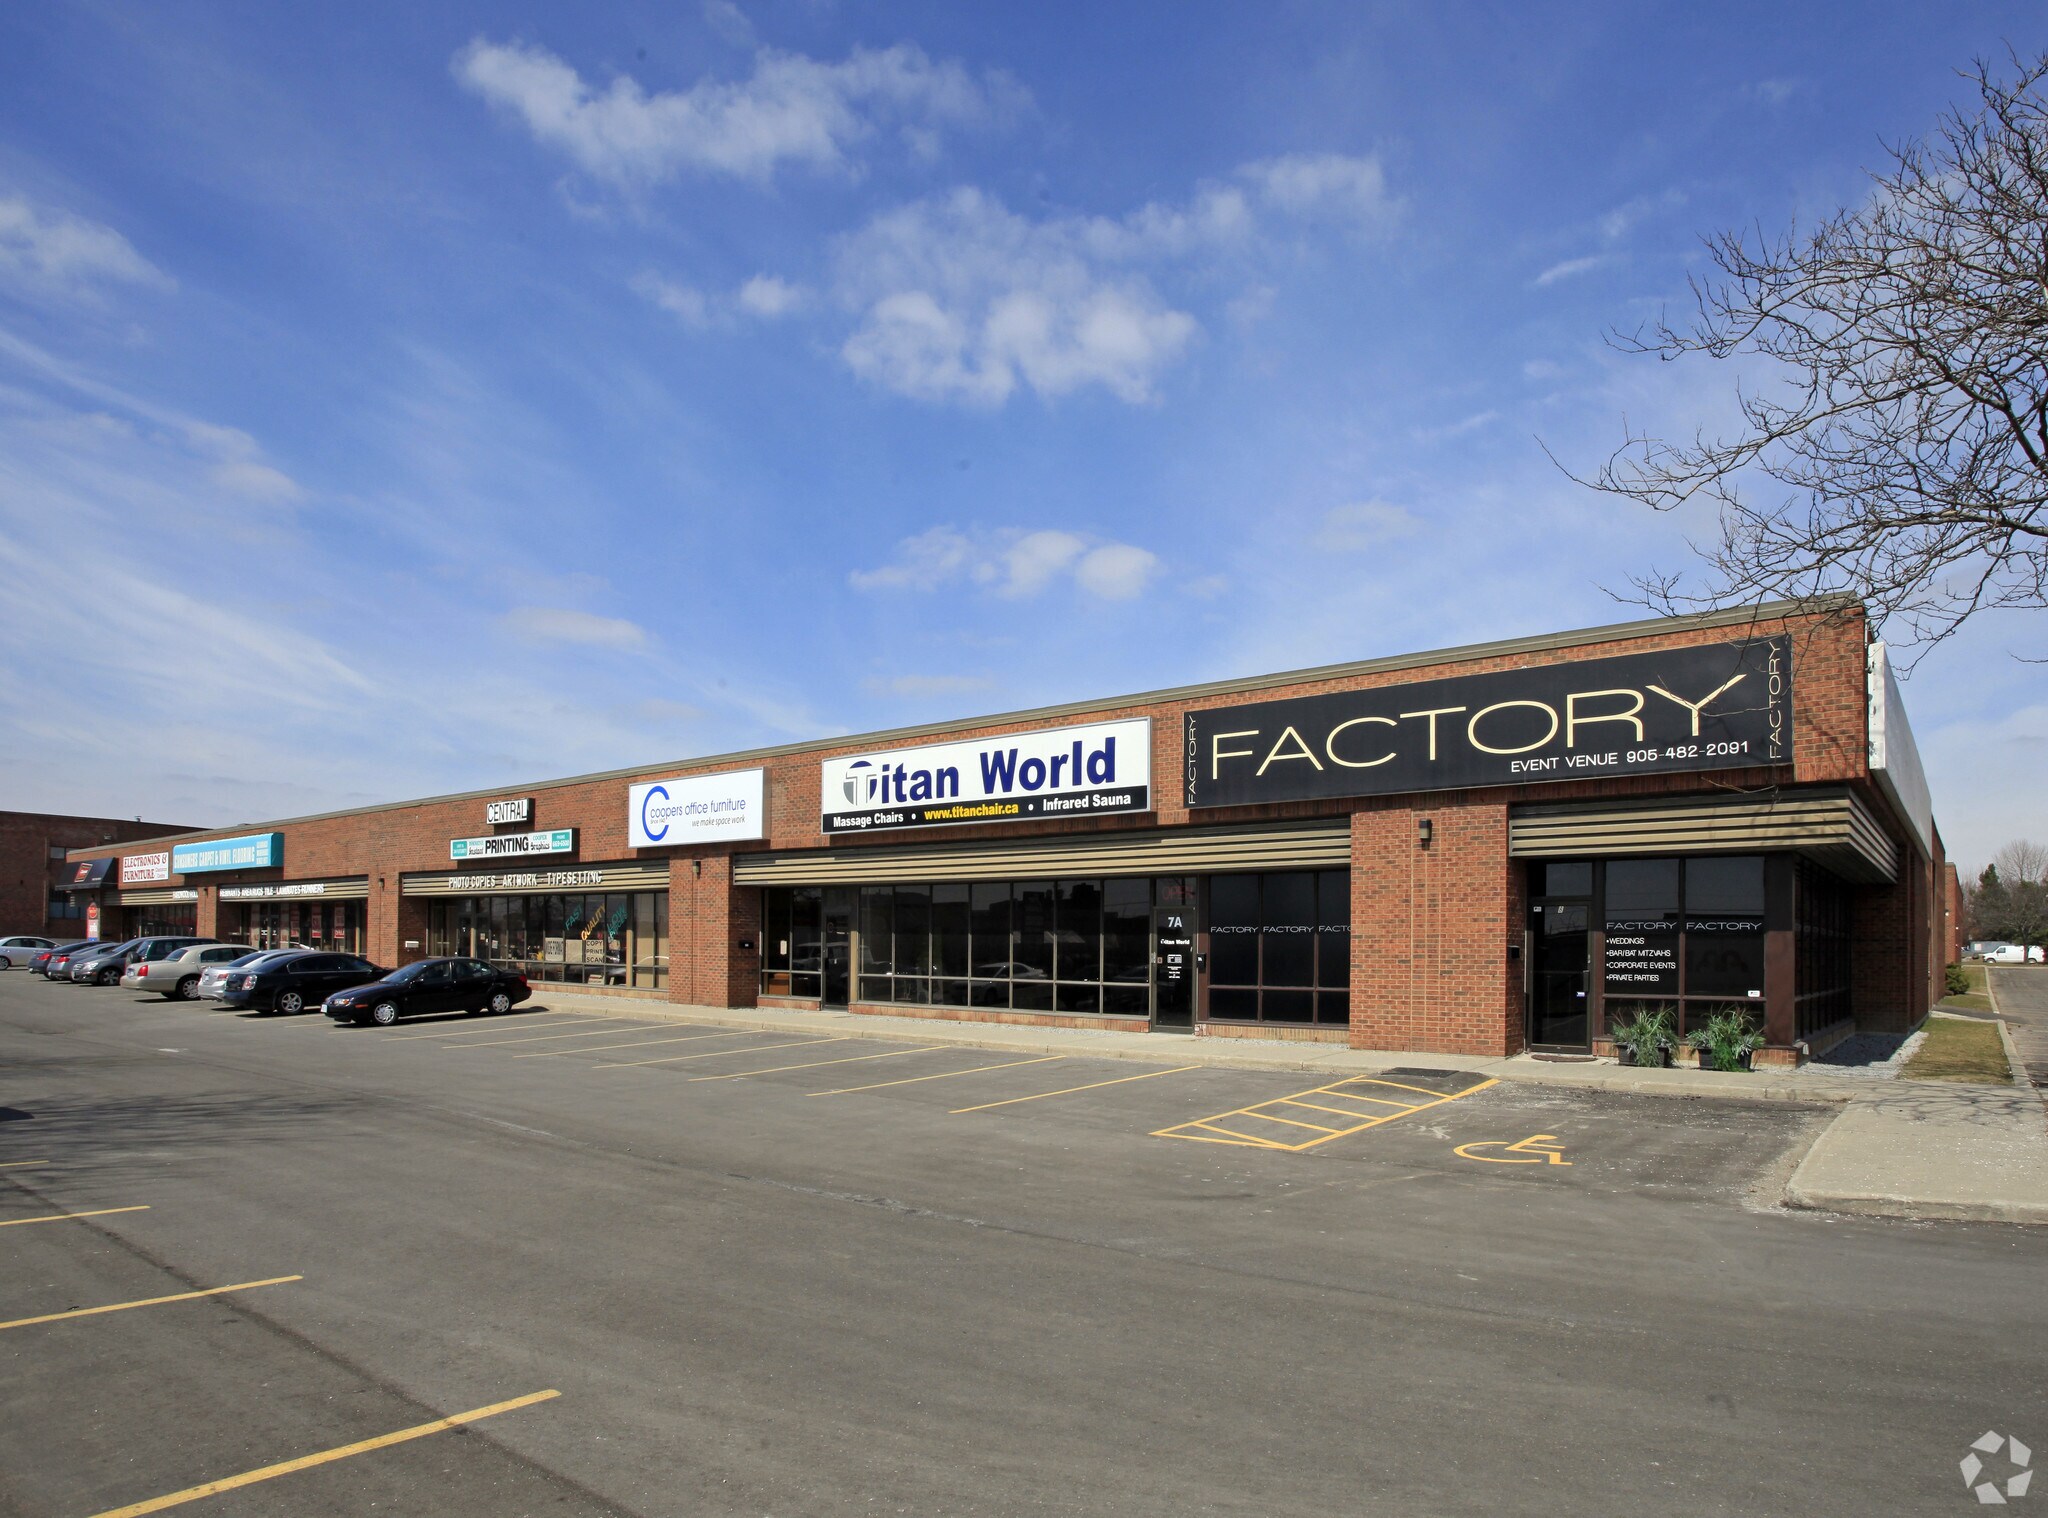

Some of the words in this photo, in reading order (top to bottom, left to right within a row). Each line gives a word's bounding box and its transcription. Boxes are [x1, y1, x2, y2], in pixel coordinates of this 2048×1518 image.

[1768, 641, 1782, 760] FACTORY
[1212, 674, 1747, 780] FACTORY
[1188, 714, 1196, 804] FACTORY
[1511, 757, 1559, 773] EVENT
[1565, 752, 1618, 768] VENUE
[1626, 741, 1749, 763] 905-482-2091
[843, 760, 960, 806] Titan
[980, 736, 1116, 795] World
[487, 801, 528, 823] CENTRAL
[650, 804, 683, 820] coopers
[684, 801, 708, 816] office
[710, 798, 746, 813] furniture
[833, 813, 872, 829] Massage
[874, 811, 904, 826] Chairs
[924, 803, 1019, 821] www.titanchair.ca
[1043, 794, 1089, 811] Infrared
[1092, 793, 1131, 807] Sauna
[699, 817, 715, 827] make
[715, 817, 731, 828] space
[731, 814, 746, 824] work
[485, 836, 529, 855] PRINTING
[124, 854, 161, 868] ELECTRONICS
[124, 868, 155, 881] FURNITURE
[448, 876, 470, 888] PHOTO
[471, 875, 496, 888] COPIES
[502, 873, 538, 887] ARTWORK
[546, 871, 602, 885] TYPESETTING
[581, 903, 606, 941] QUALITY
[1168, 916, 1183, 928] 7A
[1262, 925, 1315, 933] FACTORY
[1606, 922, 1678, 930] FACTORY
[1686, 922, 1763, 930] FACTORY
[1609, 937, 1645, 945] WEDDINGS
[1608, 949, 1636, 957] BAR/BAT
[1608, 961, 1648, 969] CORPORATE
[1649, 961, 1676, 969] EVENTS
[1608, 974, 1633, 982] PRIVATE
[1634, 974, 1660, 982] PARTIES
